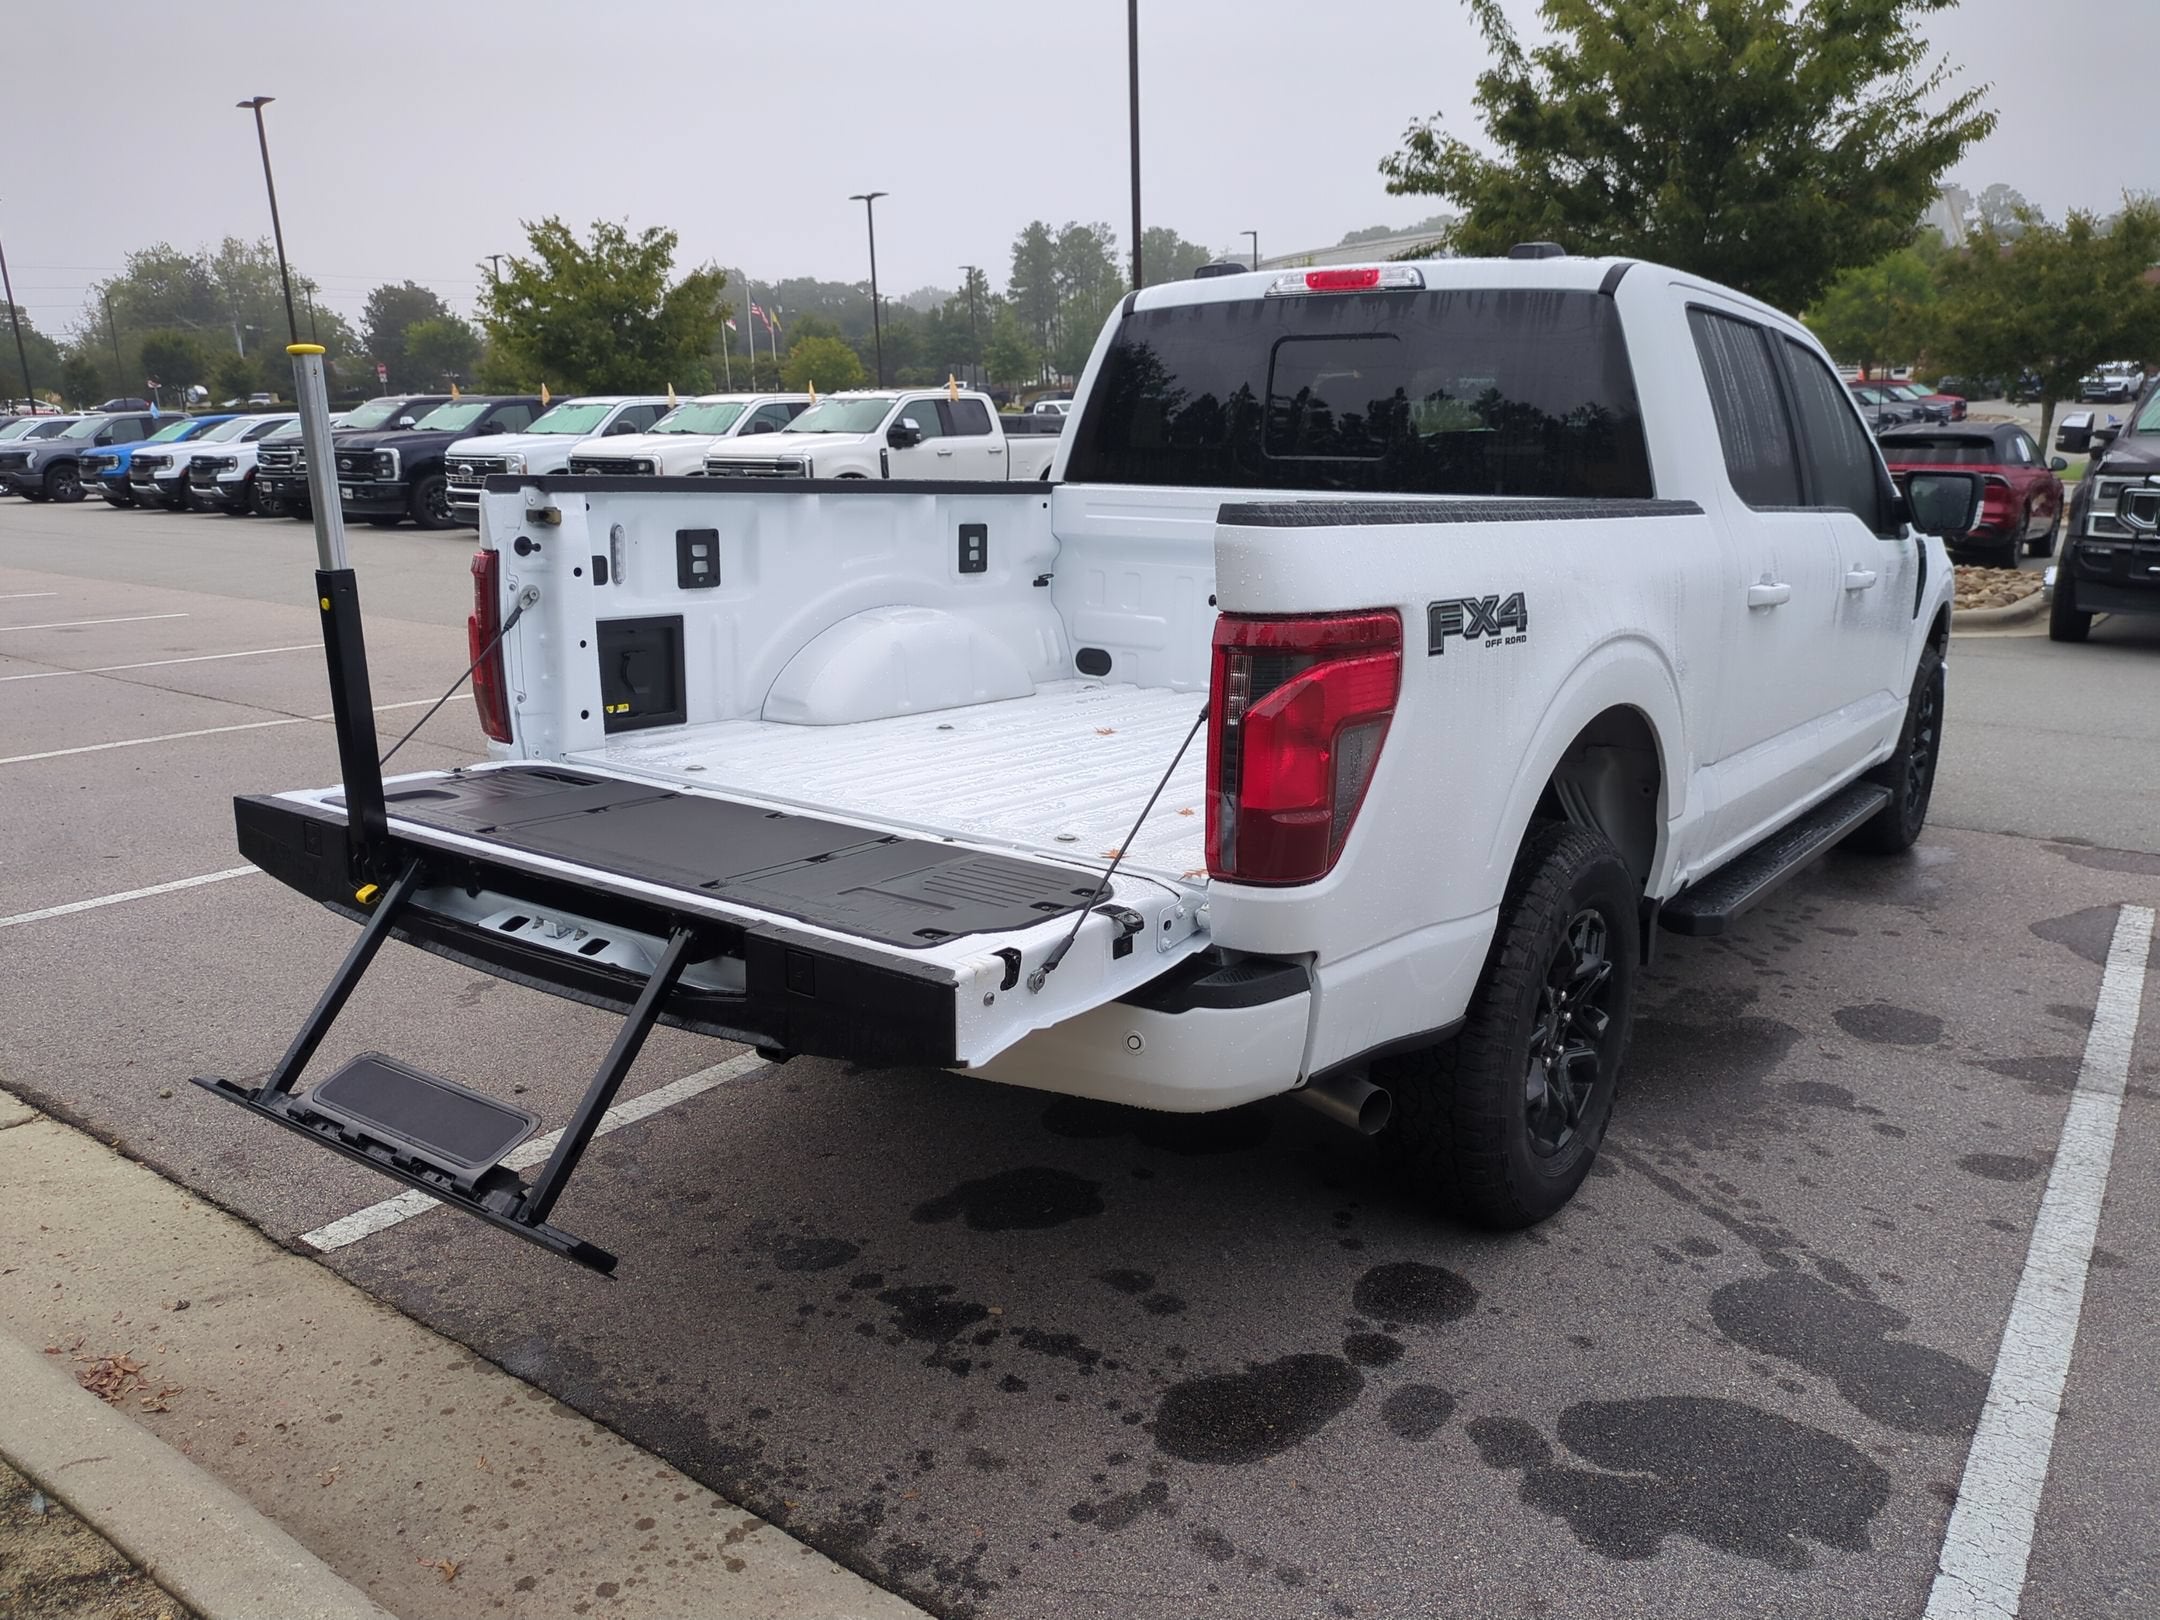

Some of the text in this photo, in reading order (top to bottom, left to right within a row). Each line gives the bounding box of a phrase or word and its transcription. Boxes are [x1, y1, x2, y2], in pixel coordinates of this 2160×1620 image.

[1427, 592, 1527, 656] FX4
[1485, 635, 1527, 648] OFF ROAD
